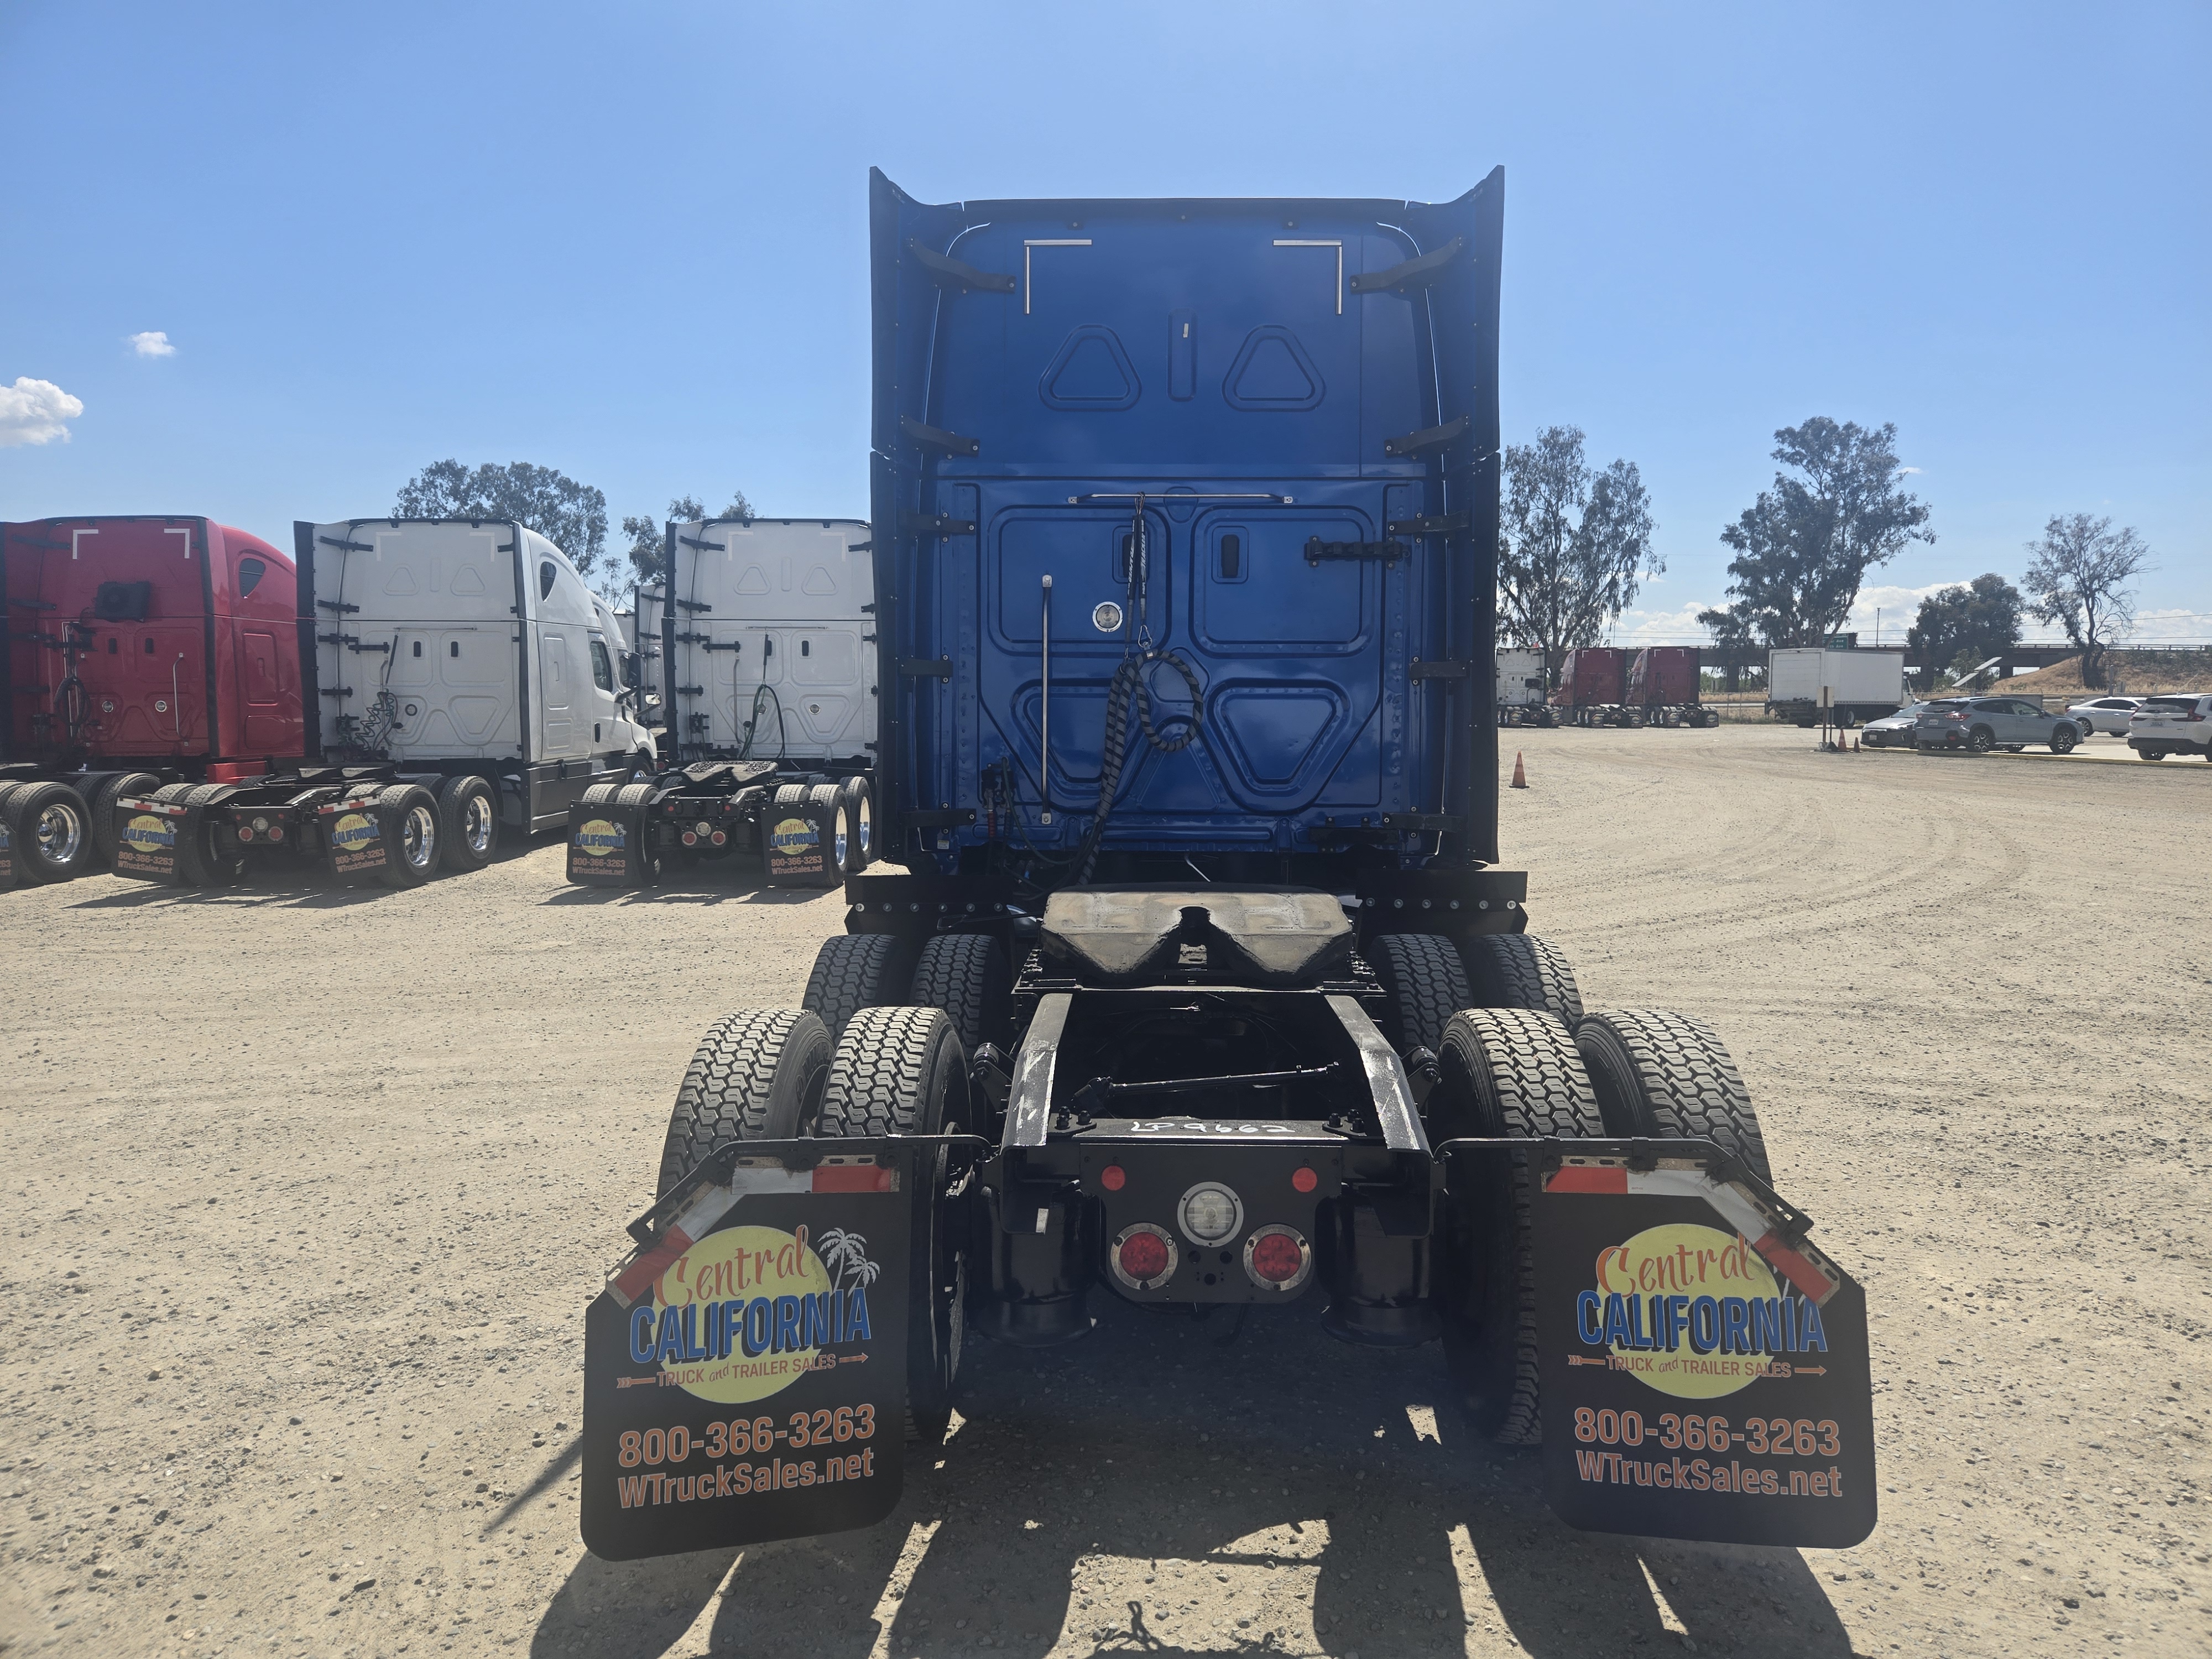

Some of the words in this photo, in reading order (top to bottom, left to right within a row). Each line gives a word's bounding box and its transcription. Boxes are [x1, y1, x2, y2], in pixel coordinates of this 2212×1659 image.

[128, 818, 163, 830] Central
[335, 813, 364, 832] Central
[580, 821, 612, 834] Central
[774, 818, 805, 835] Central
[122, 827, 175, 846] CALIFORNIA
[332, 824, 380, 844] CALIFORNIA
[575, 833, 625, 847] CALIFORNIA
[770, 831, 820, 847] CALIFORNIA
[118, 851, 174, 866] 800-366-3263
[335, 848, 385, 865] 800-366-3263
[337, 857, 387, 873] WTruckSales.net
[572, 858, 626, 868] 800-366-3263
[771, 855, 822, 867] 800-366-3263
[118, 860, 172, 874] WTruckSales.net
[572, 867, 625, 875] WTruckSales.net
[771, 864, 823, 875] WTruckSales.net
[653, 1224, 810, 1310] Central
[1596, 1231, 1755, 1298] Central
[630, 1287, 872, 1364] CALIFORNIA
[1577, 1290, 1828, 1353] CALIFORNIA
[656, 1368, 705, 1387] TRUCK
[709, 1361, 729, 1383] and
[732, 1360, 789, 1379] TRAILER
[792, 1353, 837, 1373] SALES
[1605, 1355, 1653, 1373] TRUCK
[1658, 1355, 1678, 1373] and
[1681, 1359, 1740, 1376] TRAILER
[1745, 1361, 1791, 1378] SALES
[618, 1403, 875, 1468] 800-366-3263
[1574, 1407, 1841, 1456] 800-366-3263
[618, 1447, 874, 1509] WTruckSales.net
[1575, 1449, 1843, 1498] WTruckSales.net
